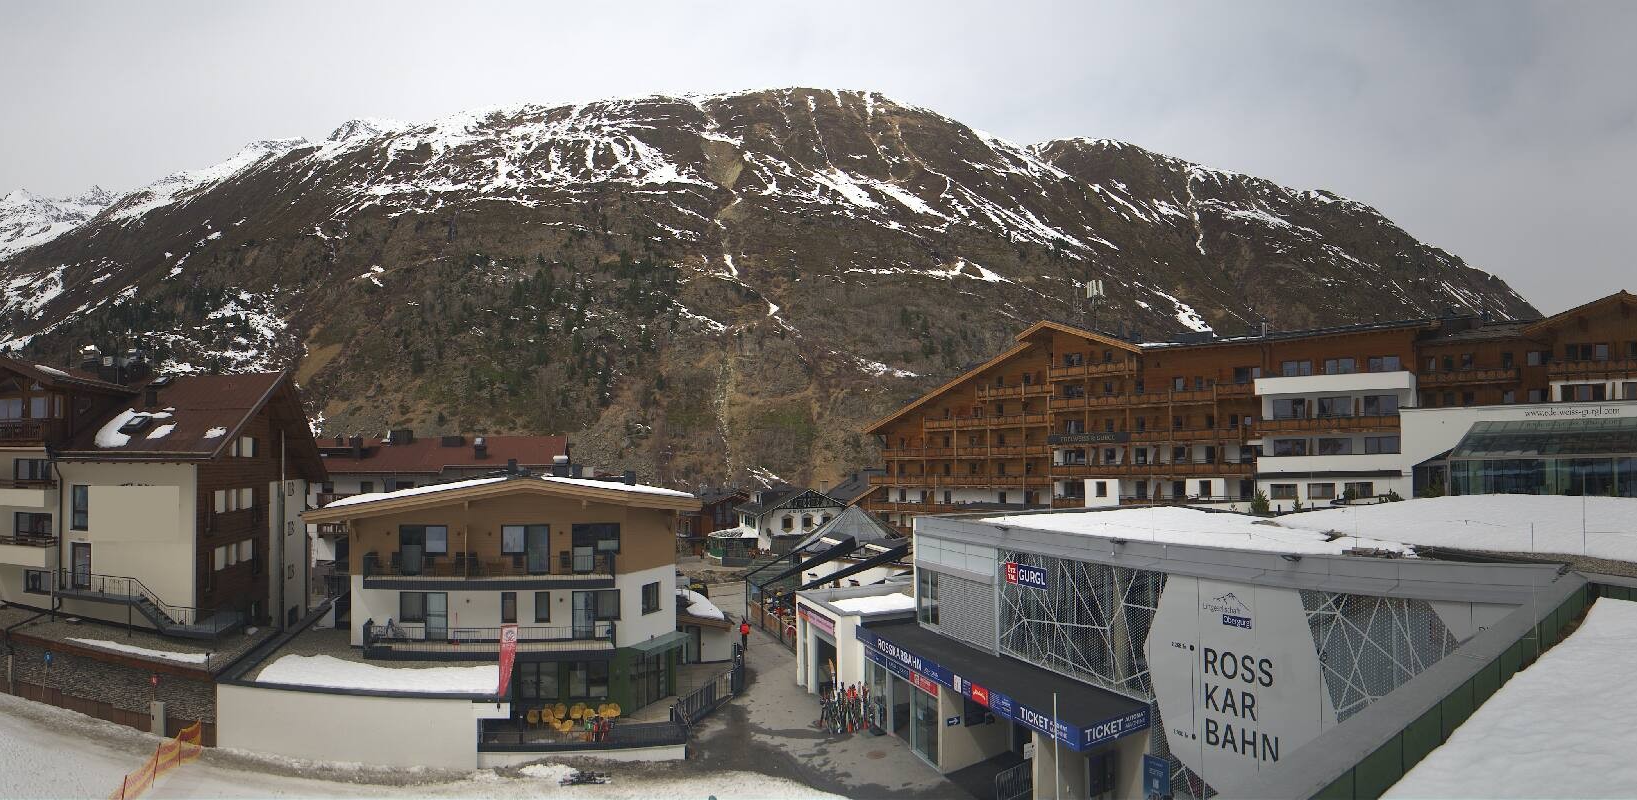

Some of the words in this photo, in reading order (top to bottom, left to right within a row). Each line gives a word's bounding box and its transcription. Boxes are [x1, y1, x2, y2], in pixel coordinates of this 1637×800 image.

[1018, 569, 1046, 586] GURGL
[877, 638, 922, 671] ROSSKARBAHN
[1203, 647, 1274, 688] ROSS
[1020, 706, 1049, 731] TICKET
[1205, 682, 1257, 722] KAR
[1085, 718, 1124, 742] TICKET
[1205, 717, 1279, 762] BAHN
